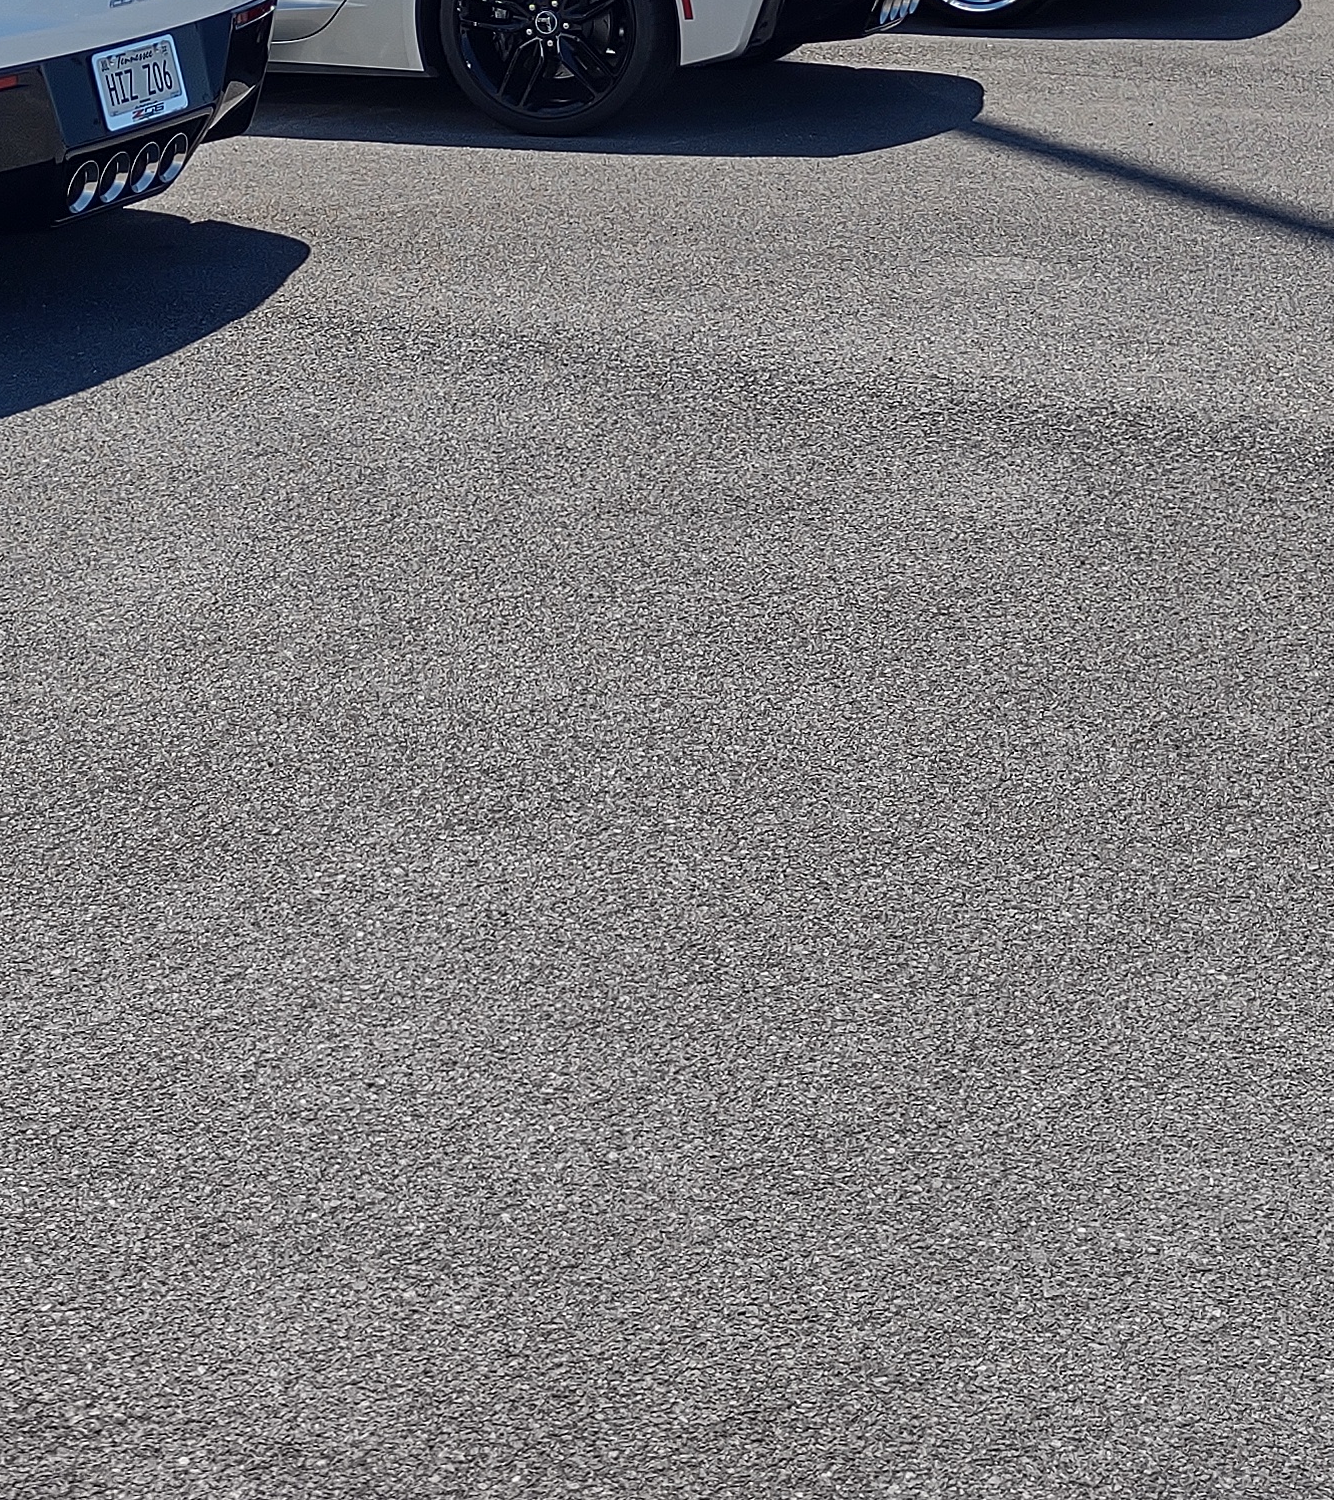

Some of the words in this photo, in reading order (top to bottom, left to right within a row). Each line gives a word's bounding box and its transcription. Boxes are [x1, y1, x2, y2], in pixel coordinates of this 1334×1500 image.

[115, 50, 154, 69] Tennessee
[105, 69, 138, 107] HIZ
[142, 60, 173, 95] Z06
